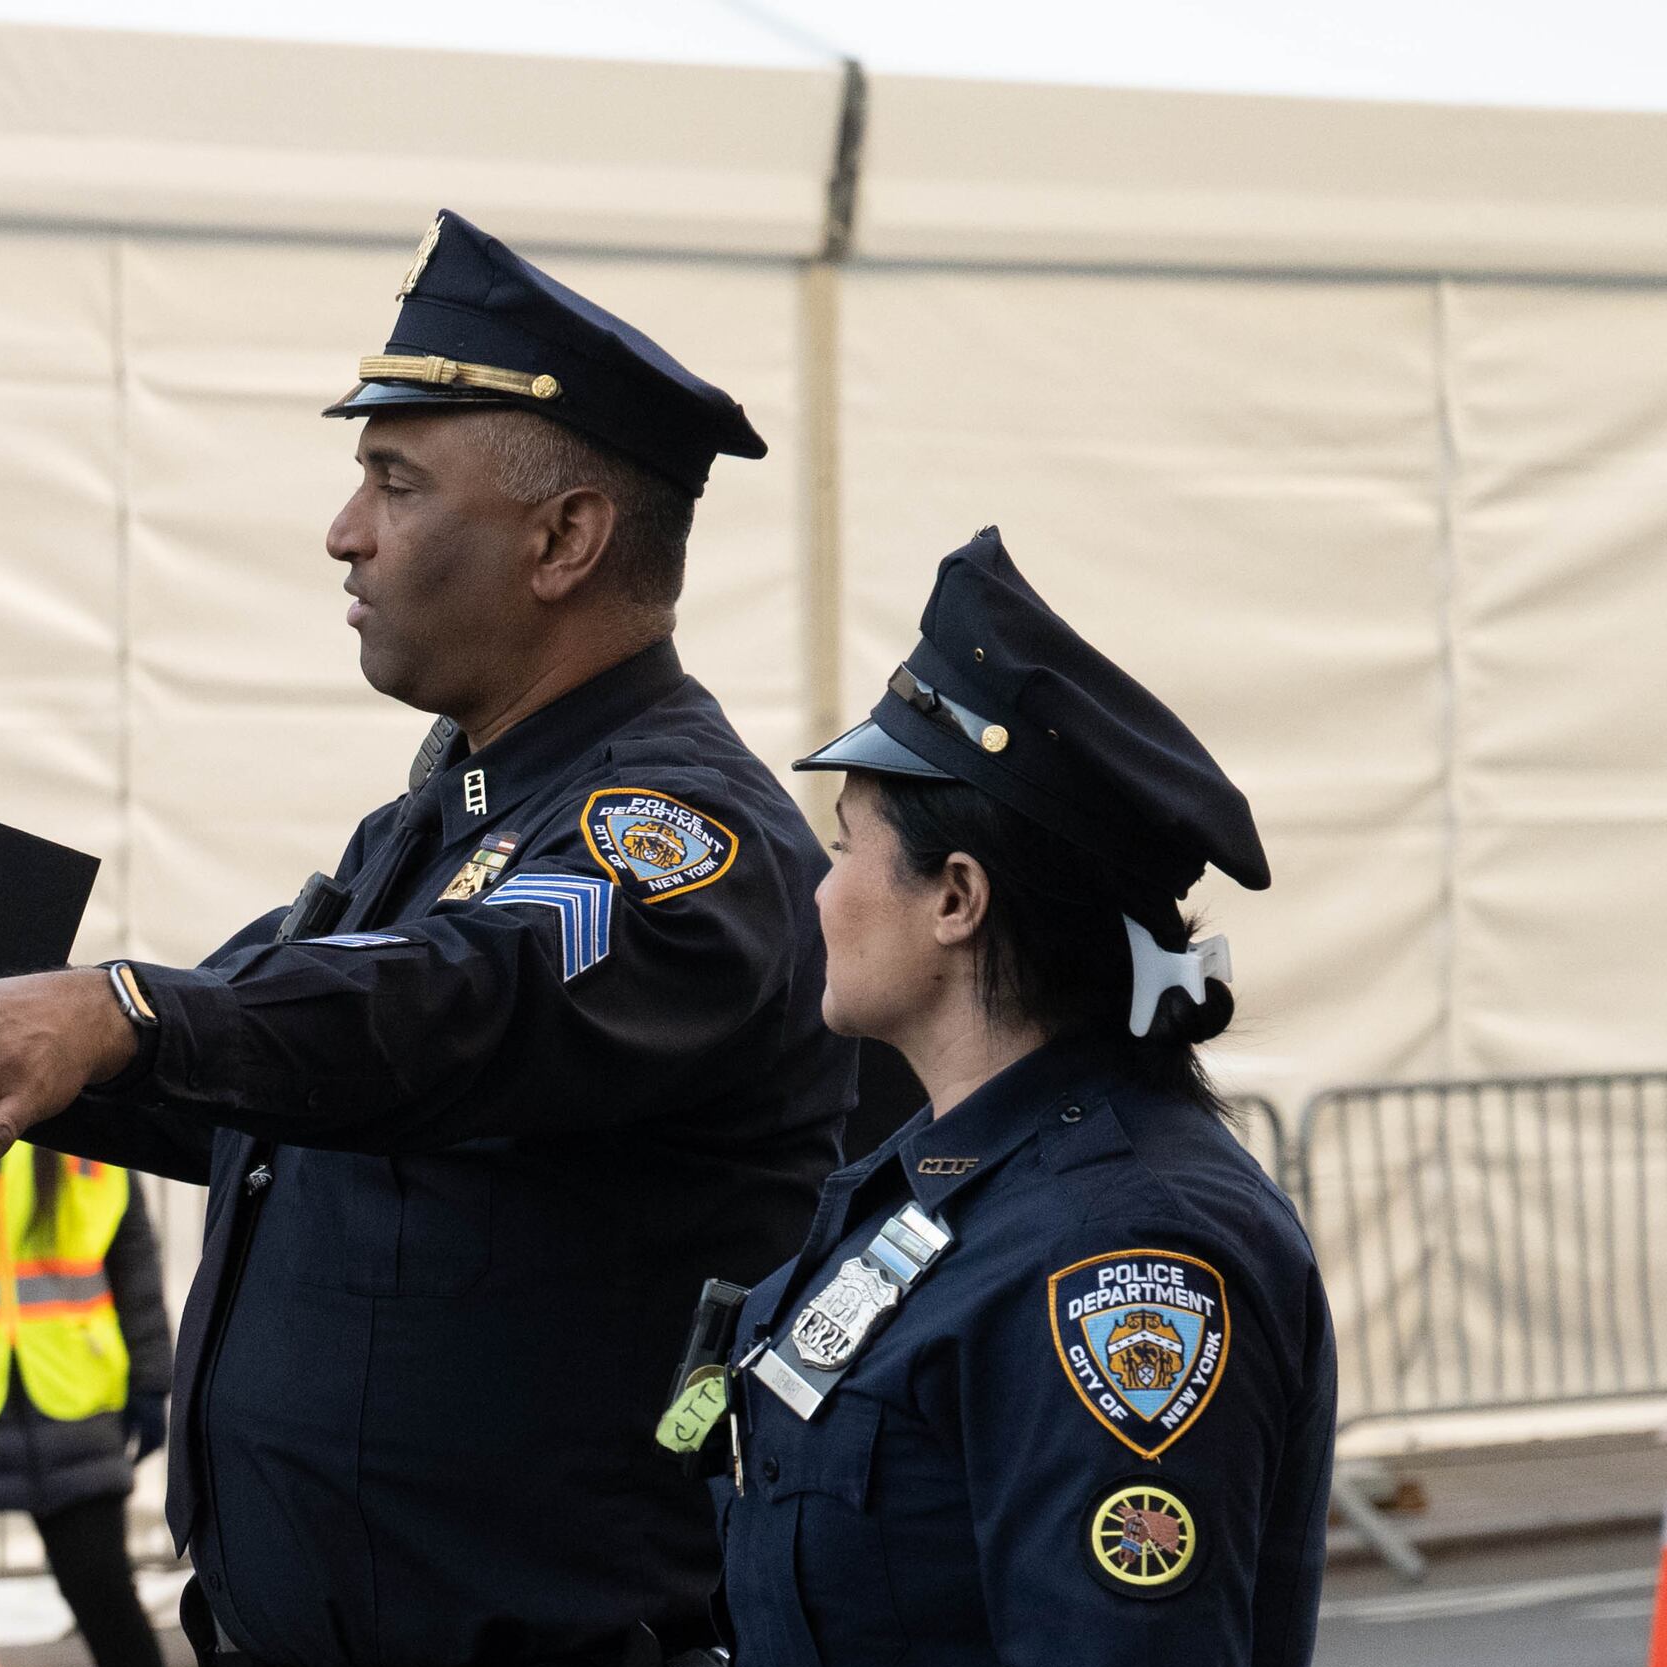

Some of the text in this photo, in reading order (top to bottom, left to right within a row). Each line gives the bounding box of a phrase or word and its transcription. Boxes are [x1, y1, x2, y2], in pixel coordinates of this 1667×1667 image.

[599, 806, 724, 853] DEPARTMENT
[631, 798, 704, 829] POLICE
[593, 824, 628, 870] CITY OF
[647, 856, 719, 892] NEW YORK
[1098, 1263, 1184, 1289] POLICE
[1068, 1283, 1215, 1320] DEPARTMENT
[1069, 1345, 1129, 1420] CITY OF
[1159, 1331, 1222, 1429] NEW YORK
